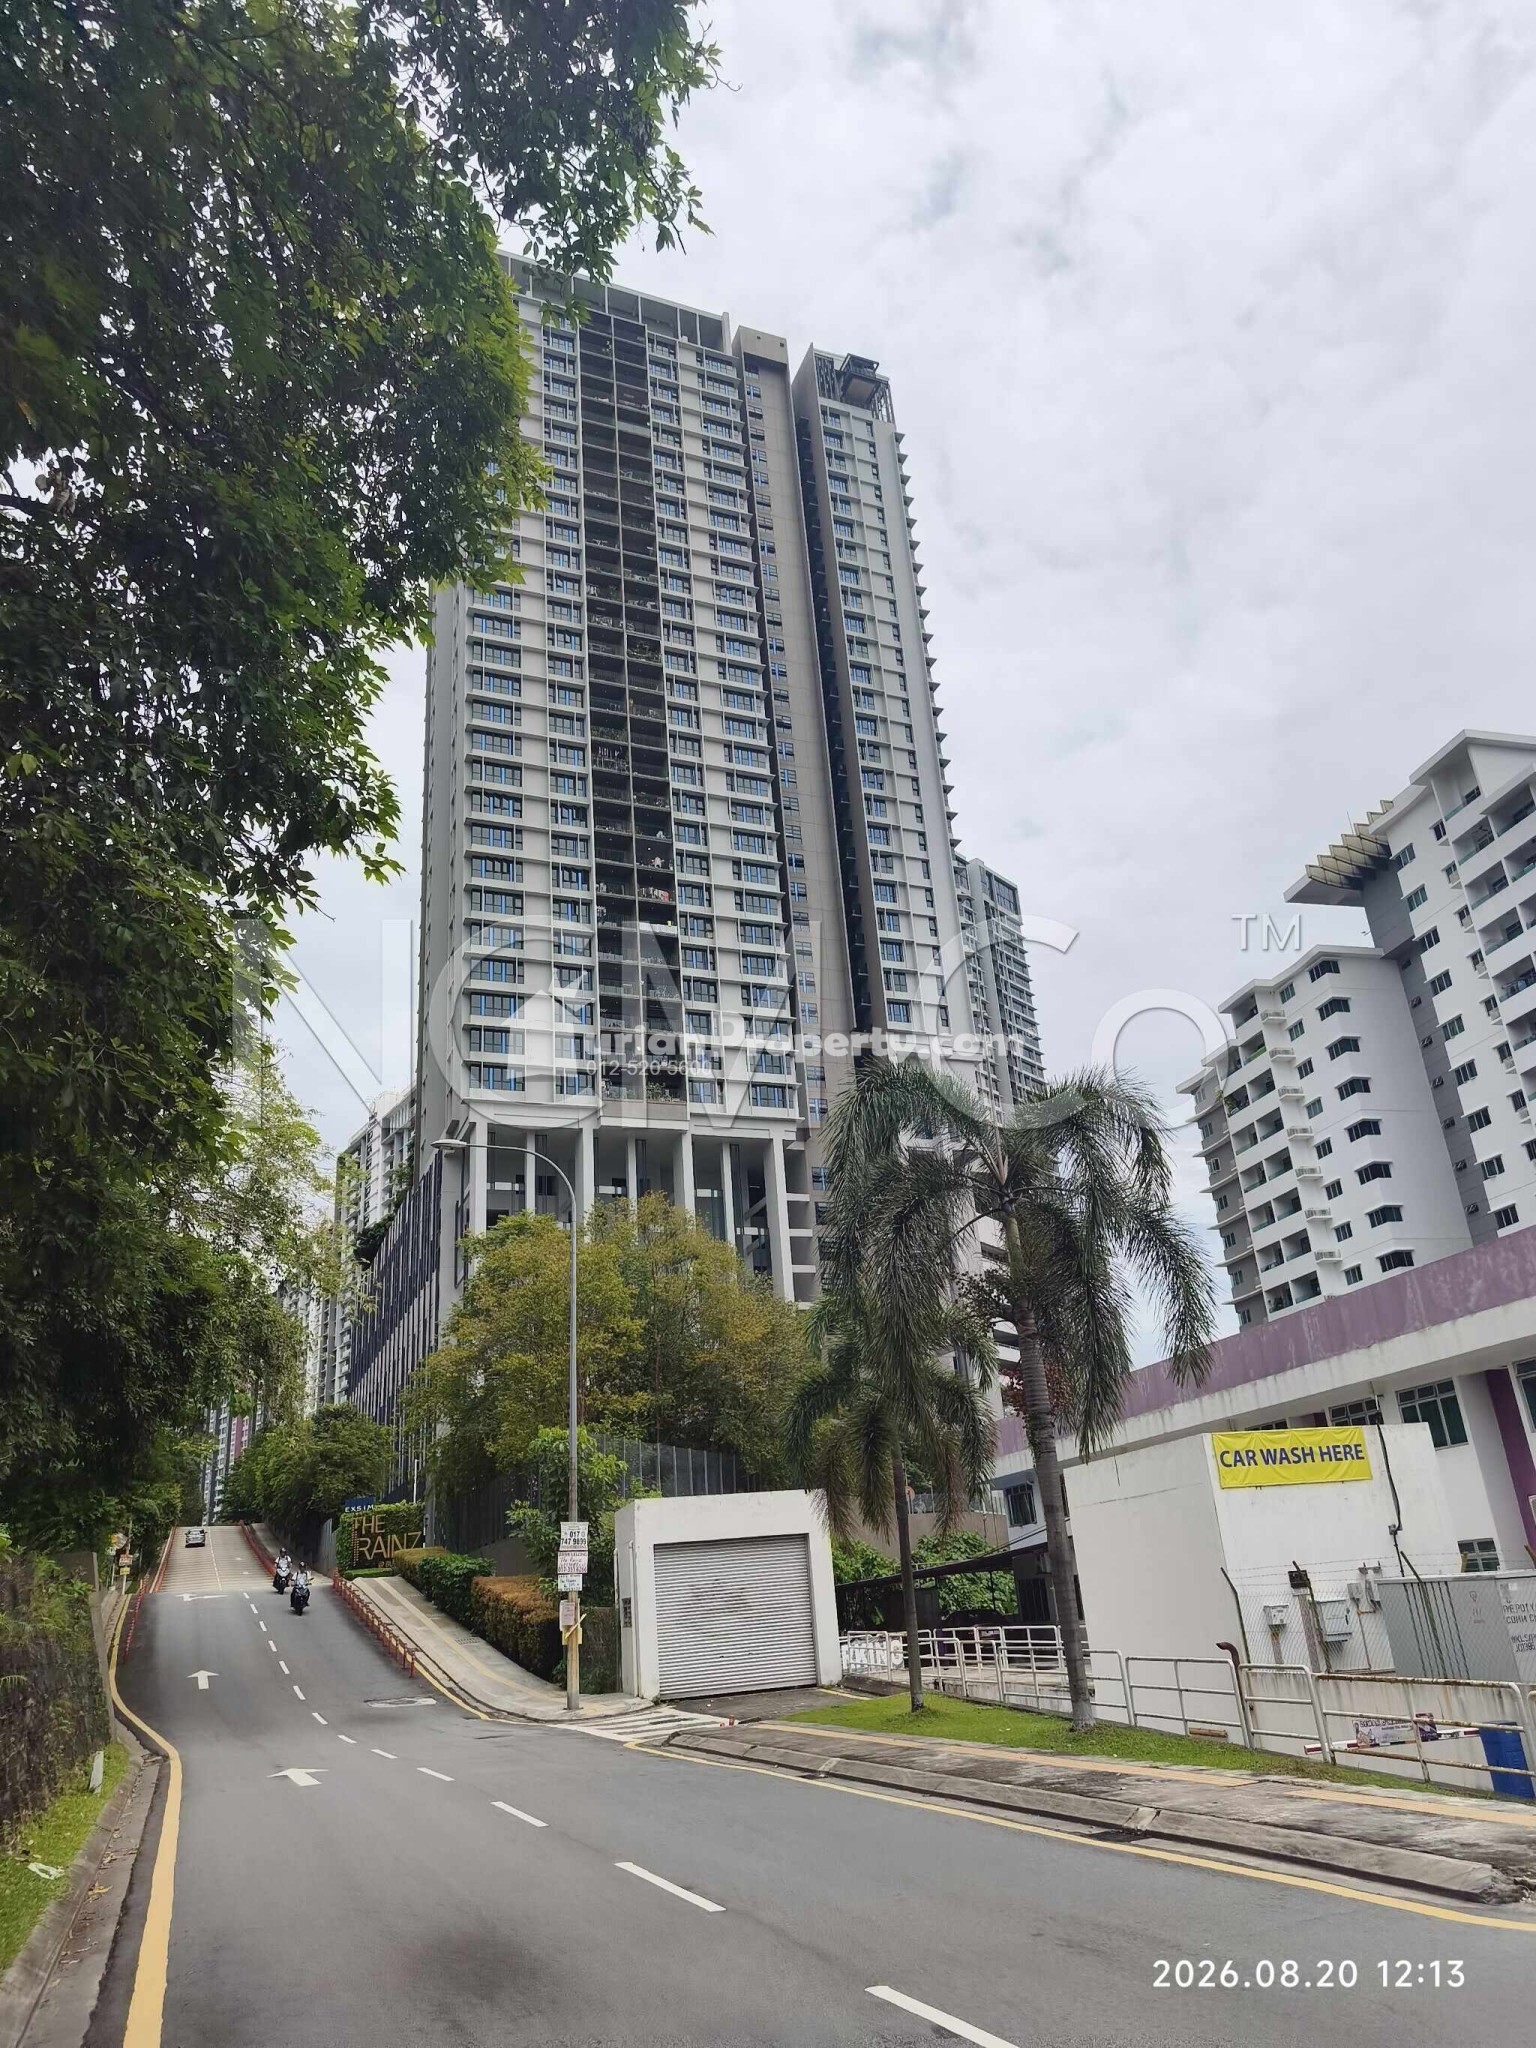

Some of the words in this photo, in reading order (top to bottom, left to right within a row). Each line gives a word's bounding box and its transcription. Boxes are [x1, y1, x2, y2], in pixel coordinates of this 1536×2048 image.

[1219, 1450, 1258, 1468] CAR
[1260, 1446, 1315, 1466] WASH
[1318, 1443, 1365, 1462] HERE
[344, 1504, 374, 1513] EXSIM
[353, 1514, 386, 1535] THE
